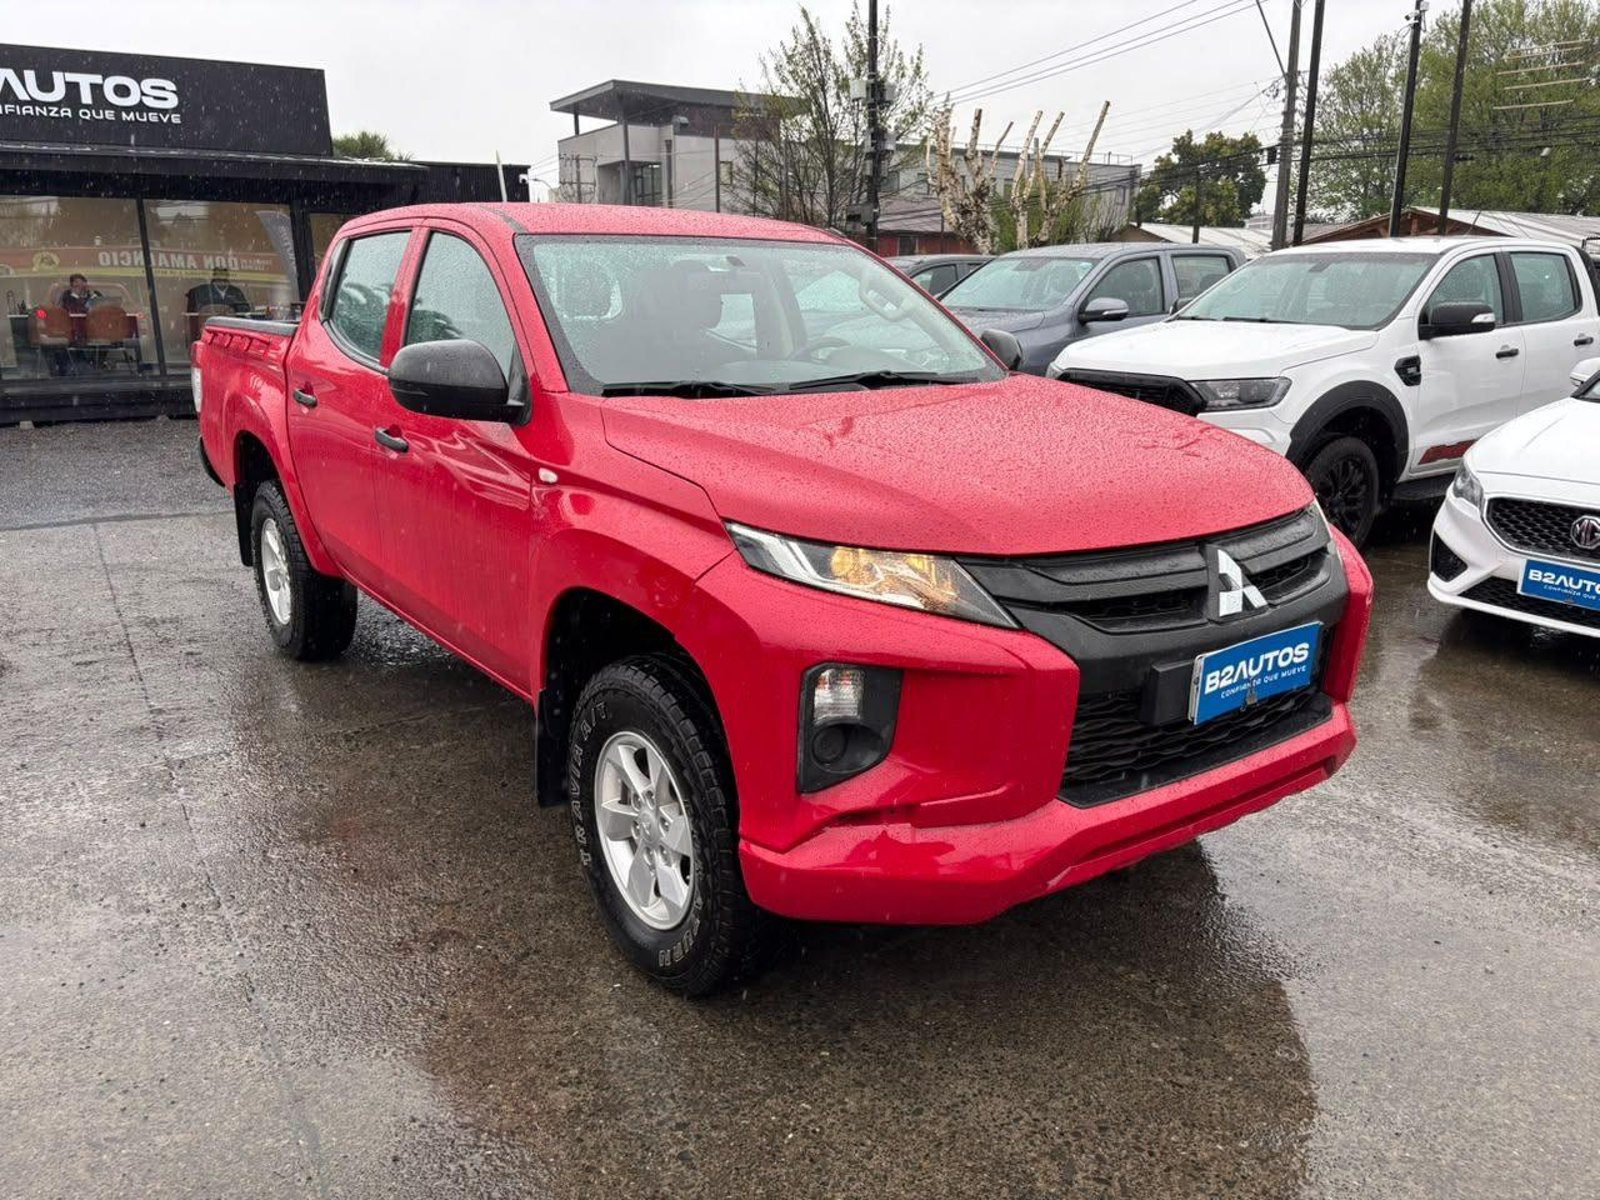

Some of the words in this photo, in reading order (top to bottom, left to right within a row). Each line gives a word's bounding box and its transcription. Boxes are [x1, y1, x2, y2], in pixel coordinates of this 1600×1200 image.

[79, 109, 115, 121] QUE
[122, 111, 181, 124] MUEVE
[1204, 642, 1309, 695] B2AUTOS
